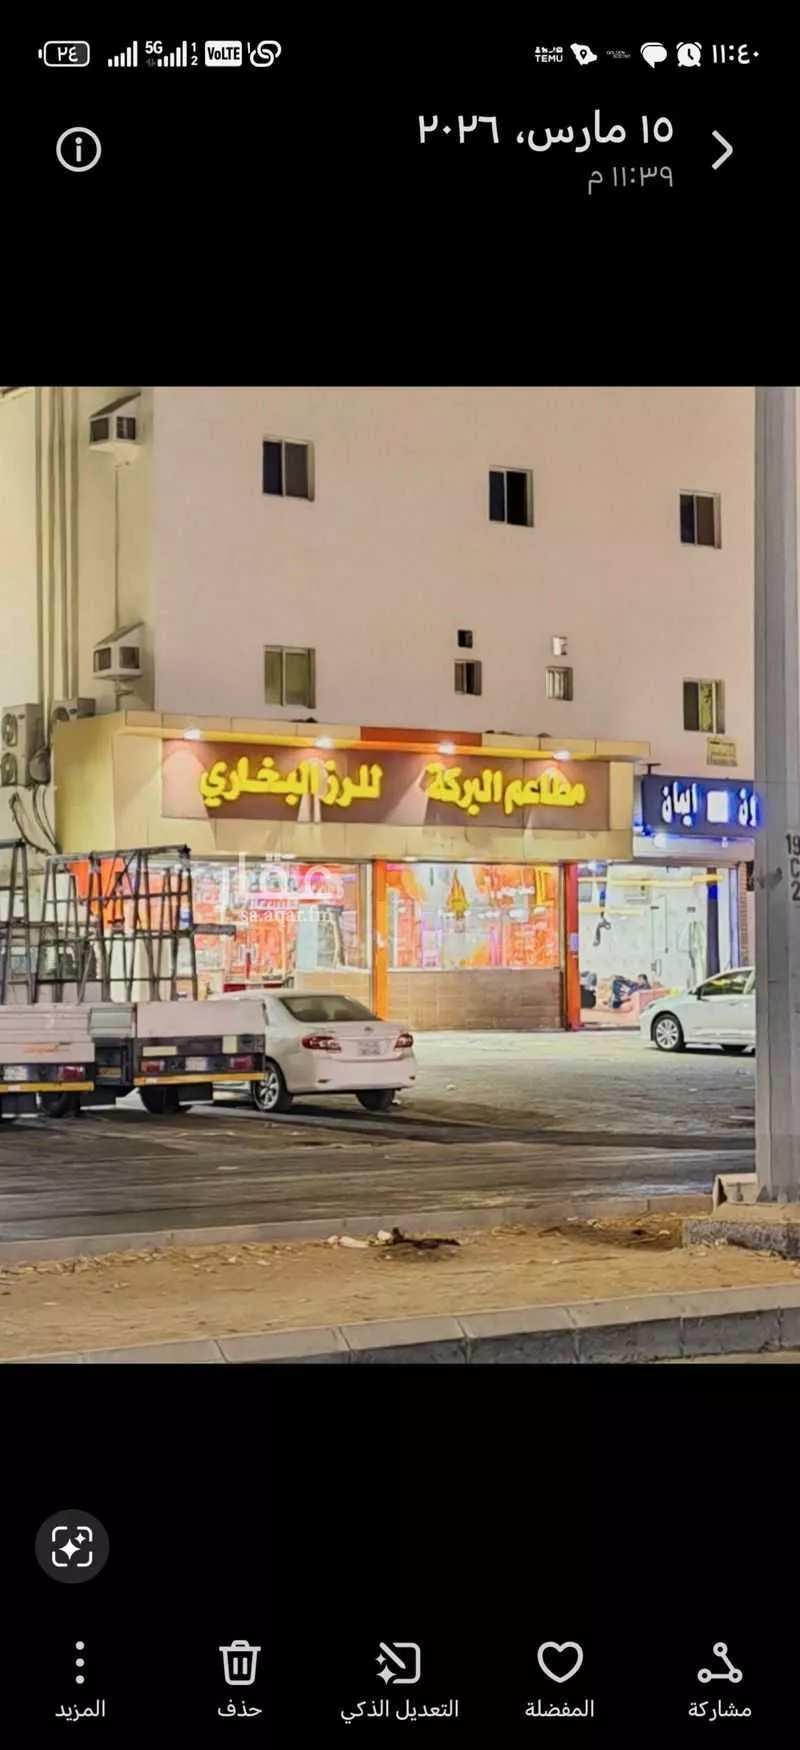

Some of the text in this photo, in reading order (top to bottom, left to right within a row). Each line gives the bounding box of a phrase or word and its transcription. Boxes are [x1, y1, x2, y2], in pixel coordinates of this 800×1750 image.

[200, 756, 586, 816] مطاعم البركة للرز البخاري
